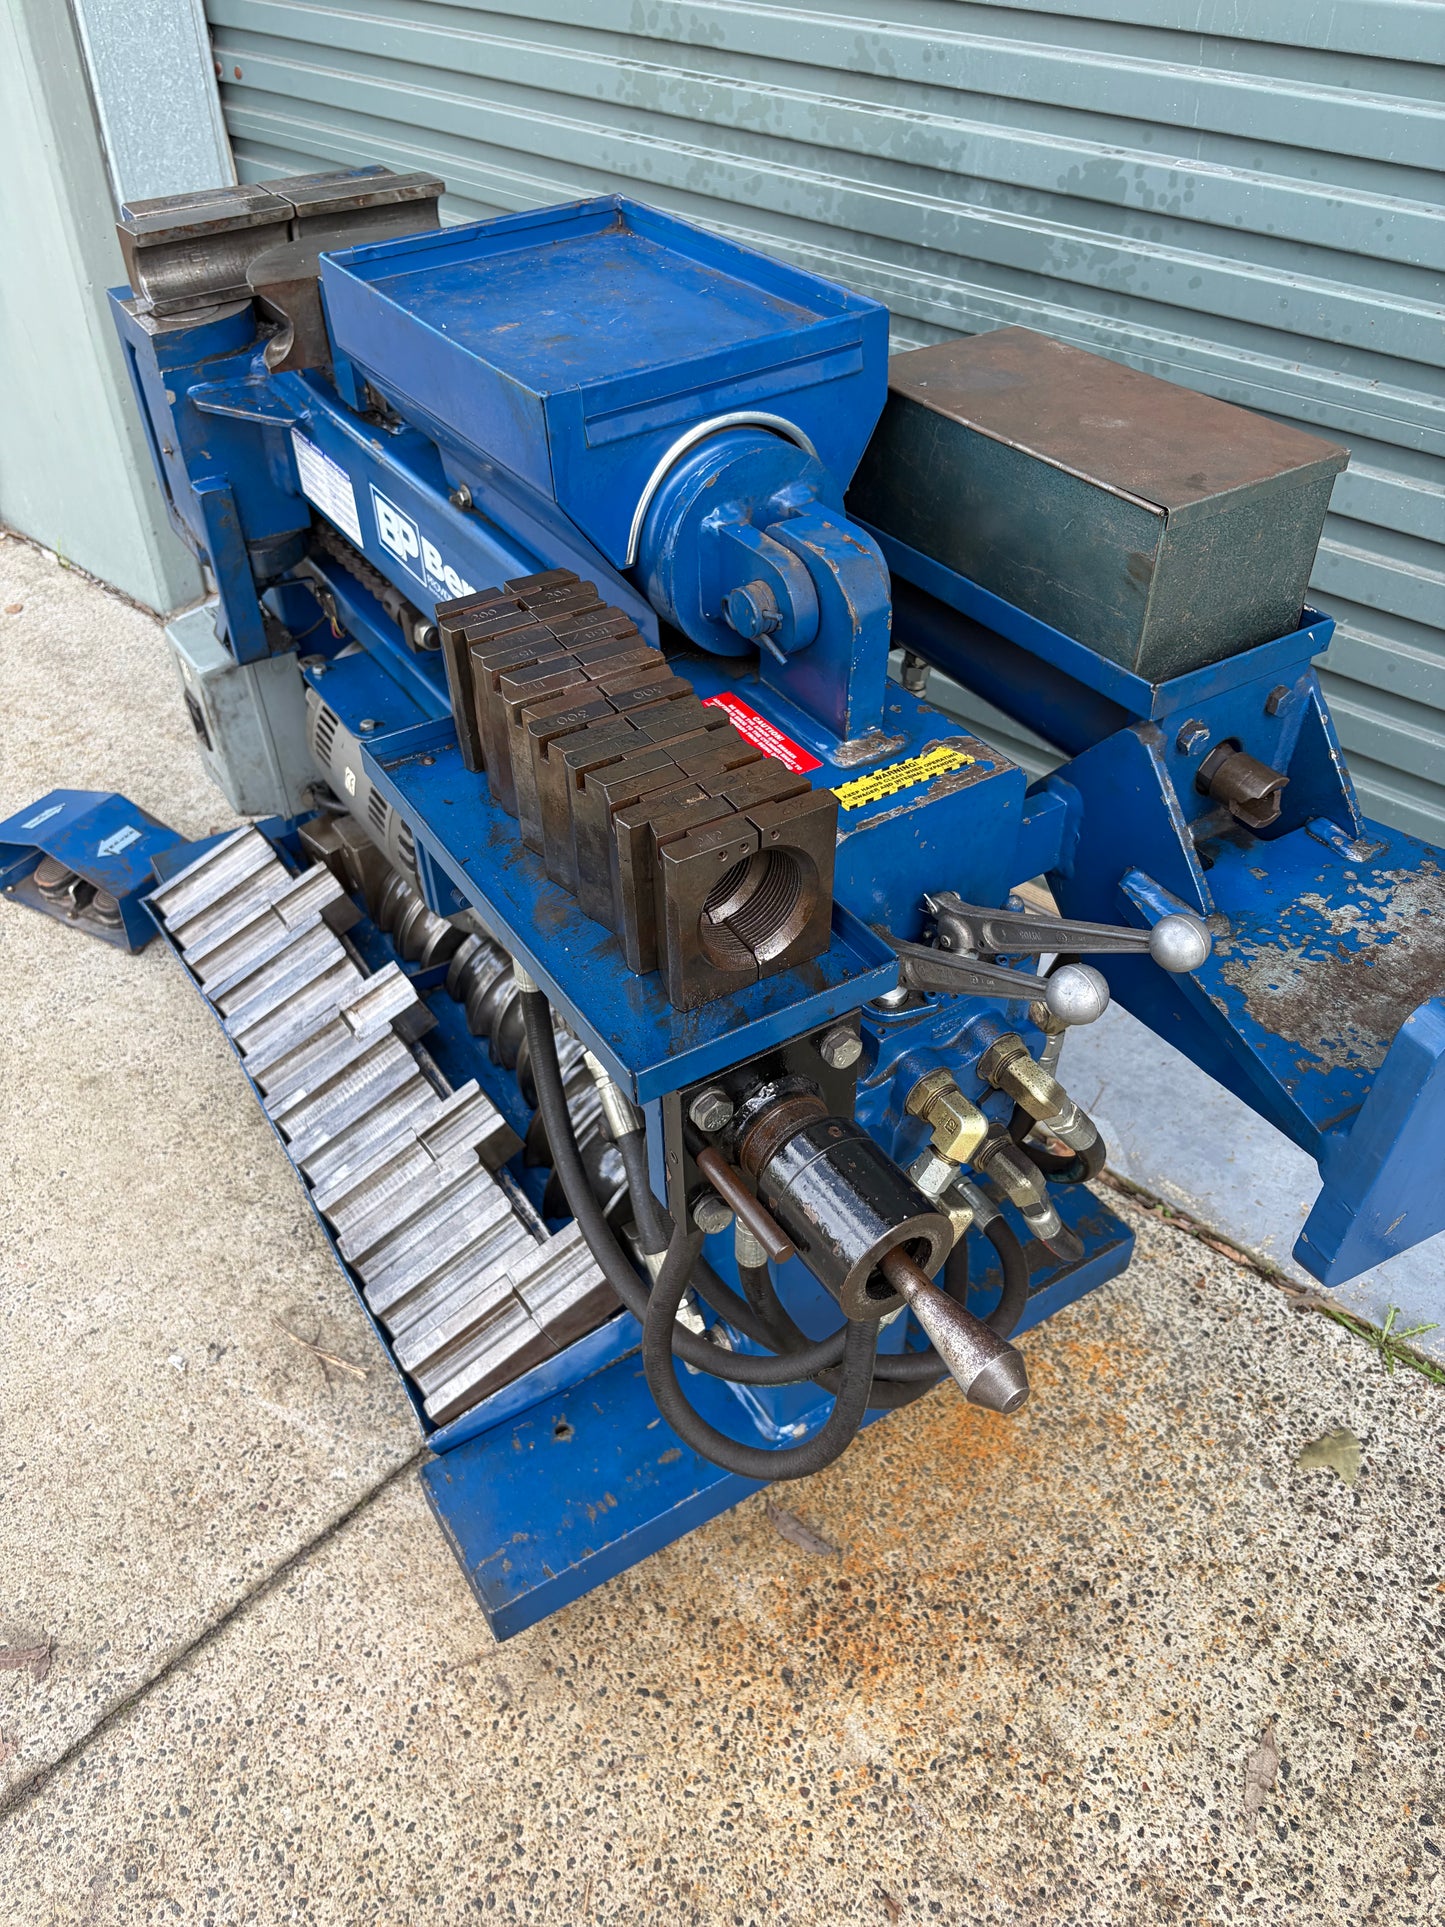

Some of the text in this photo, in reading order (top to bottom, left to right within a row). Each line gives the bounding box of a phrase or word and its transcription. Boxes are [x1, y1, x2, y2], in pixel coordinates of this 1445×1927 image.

[375, 495, 419, 562] BP
[752, 716, 785, 741] CAUTION!
[843, 752, 958, 799] KEEP HANDS CLEAR WHEN OPERATING
[852, 757, 957, 800] SWAGER AND INTERNAL EXPANDER
[873, 762, 919, 781] WARNING!
